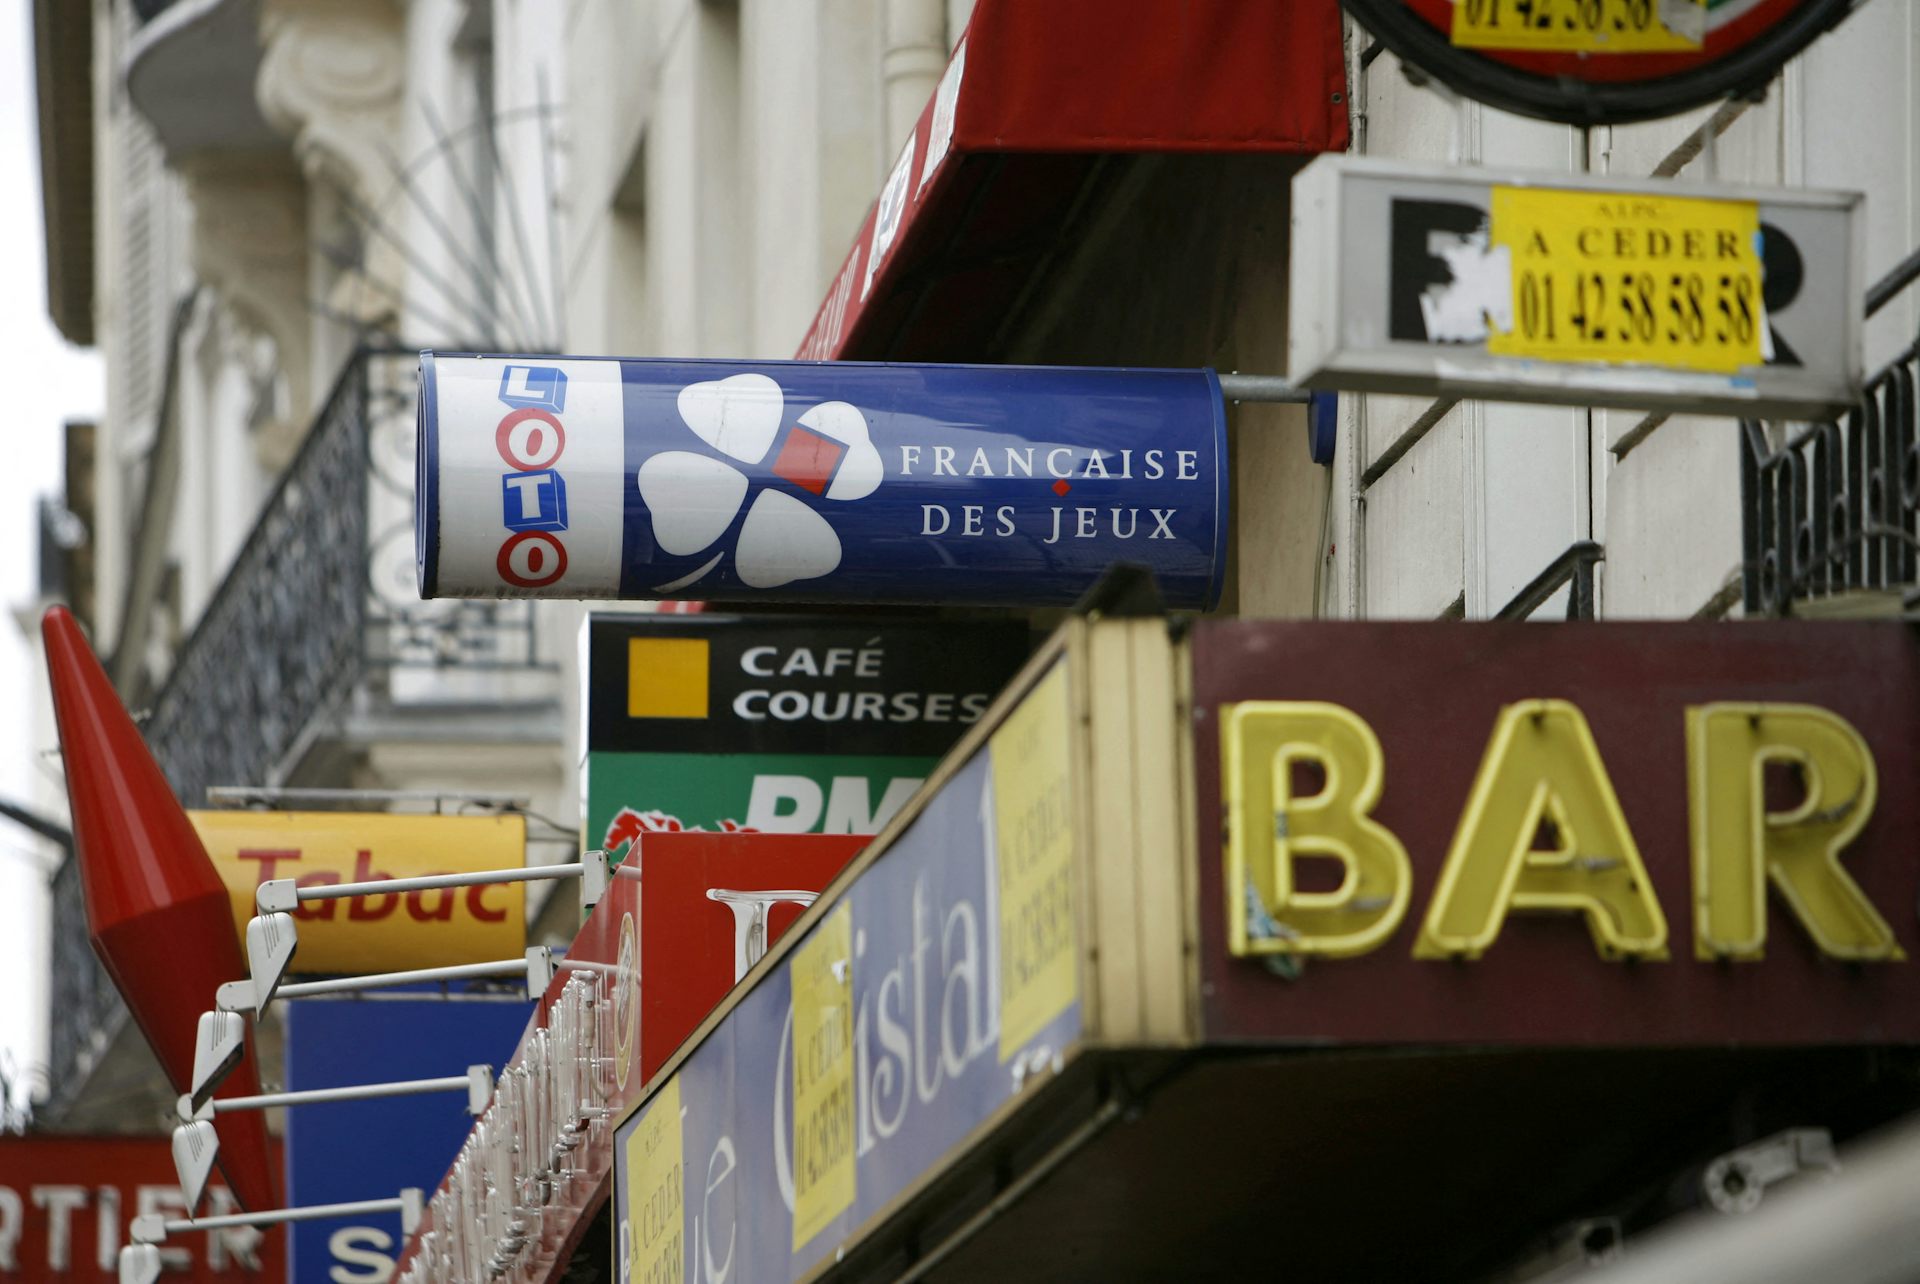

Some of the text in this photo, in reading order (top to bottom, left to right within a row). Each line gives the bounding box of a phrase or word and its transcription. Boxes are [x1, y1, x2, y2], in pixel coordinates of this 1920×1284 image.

[1527, 226, 1741, 260] A CEDER
[496, 364, 569, 589] LOTO
[920, 504, 1177, 544] DES JEUX
[740, 636, 884, 678] CAFÉ
[732, 690, 991, 723] COURSES
[744, 774, 927, 834] PM
[1219, 698, 1907, 960] BAR
[238, 848, 510, 923] Tabac
[643, 1163, 681, 1249] CEDER
